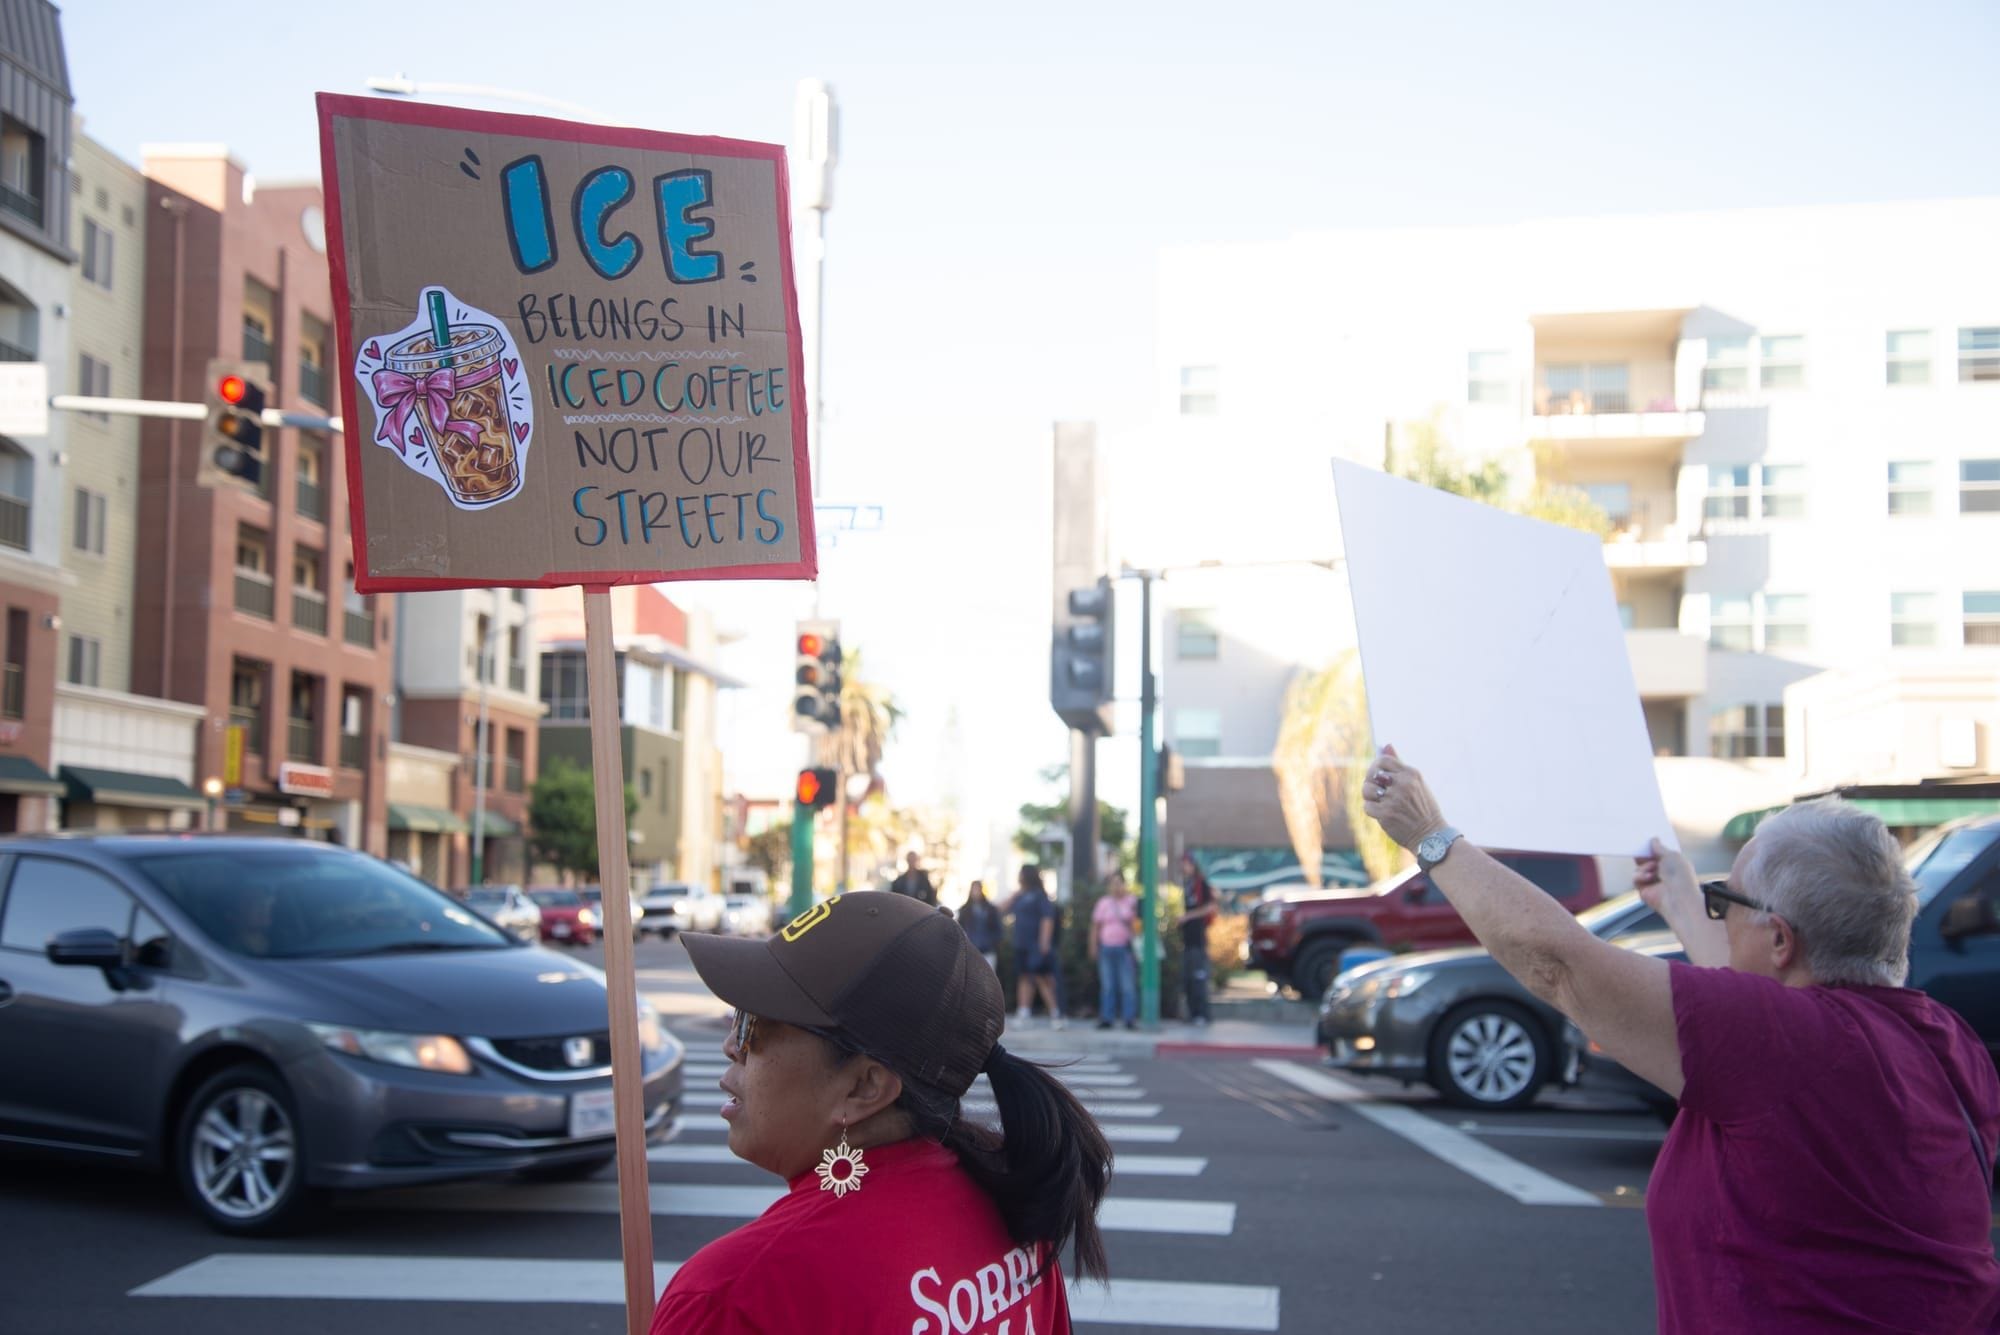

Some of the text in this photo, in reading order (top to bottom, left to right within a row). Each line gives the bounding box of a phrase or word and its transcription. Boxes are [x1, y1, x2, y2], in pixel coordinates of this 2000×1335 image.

[500, 154, 725, 285] ICE
[518, 294, 745, 344] BELONGS IN
[546, 361, 784, 416] ICED COFFEE
[574, 427, 781, 485] NOT OUR
[572, 486, 785, 548] STREETS
